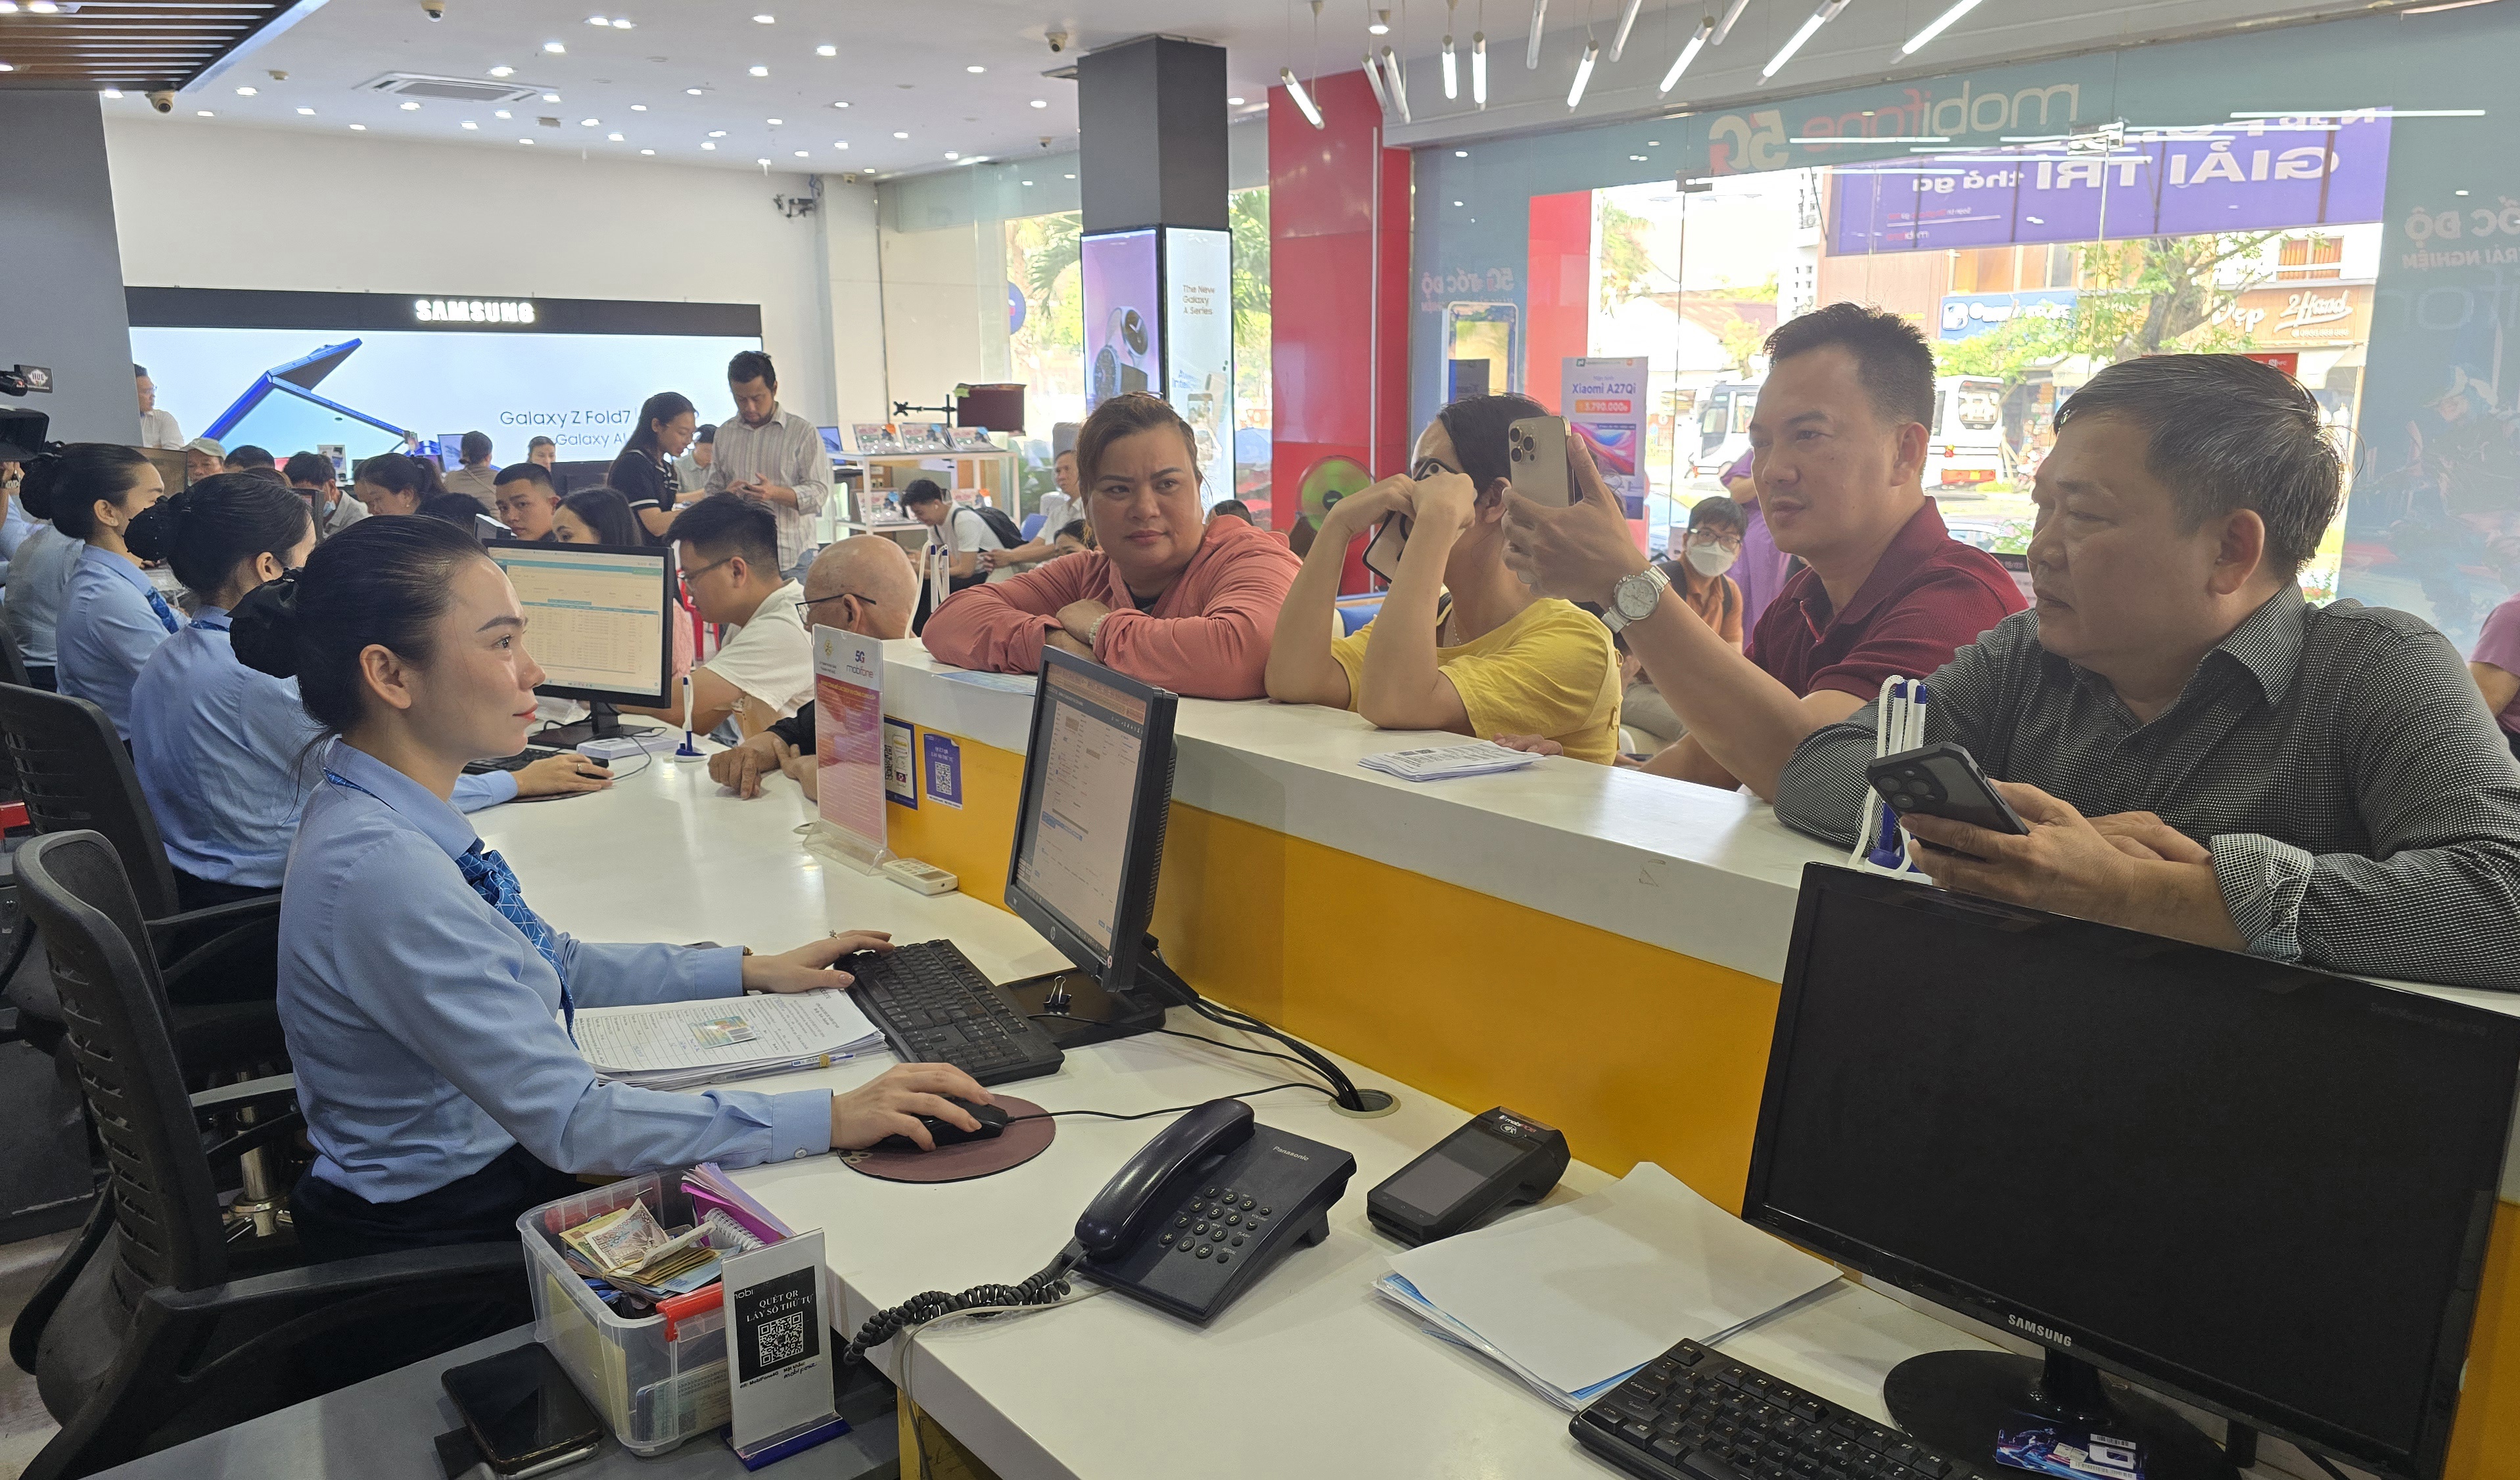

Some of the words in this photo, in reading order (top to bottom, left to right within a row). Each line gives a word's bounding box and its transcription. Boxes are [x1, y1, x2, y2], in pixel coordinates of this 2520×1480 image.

[1182, 285, 1196, 293] The
[1198, 285, 1215, 294] New
[1182, 296, 1209, 306] Galaxy
[415, 299, 535, 323] SAMSUNG
[1572, 382, 1604, 394] Xiaomi
[1606, 382, 1637, 395] A27Qi
[500, 411, 568, 428] Galaxy
[571, 411, 581, 425] Z
[586, 410, 631, 425] Fold7
[555, 433, 609, 448] Galaxy
[854, 650, 865, 664] 5G
[845, 664, 874, 679] mobifone
[1272, 1145, 1310, 1161] Panasonic
[759, 1294, 784, 1308] QUÉT
[785, 1289, 799, 1300] QR
[2008, 1314, 2072, 1347] SAMSUNG
[1604, 1406, 1617, 1416] CTRL
